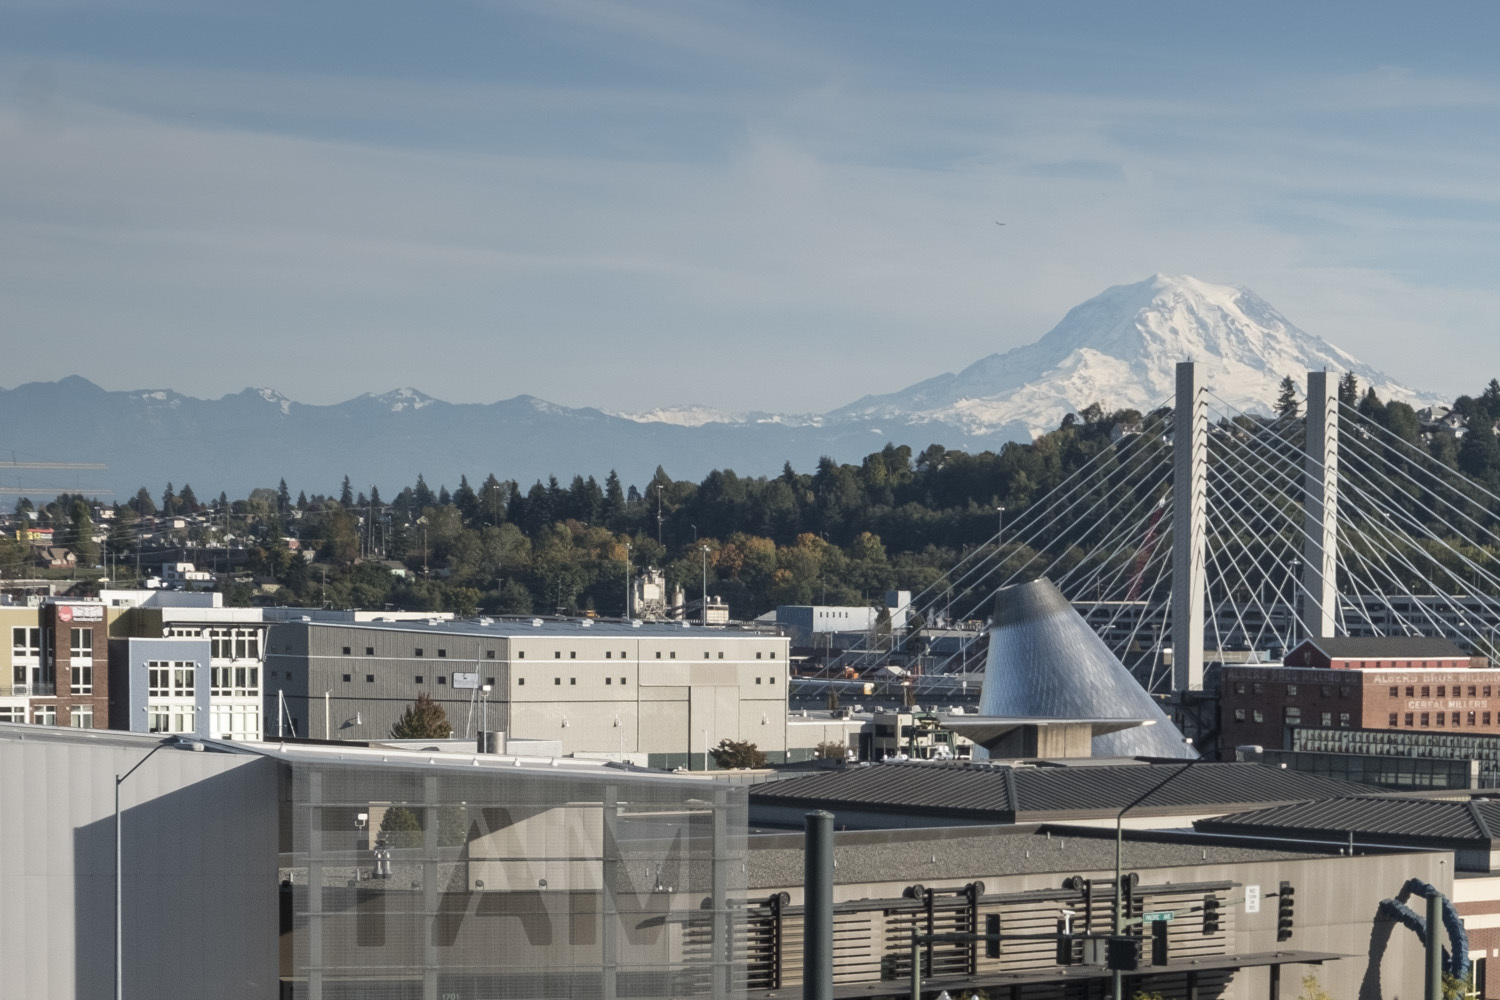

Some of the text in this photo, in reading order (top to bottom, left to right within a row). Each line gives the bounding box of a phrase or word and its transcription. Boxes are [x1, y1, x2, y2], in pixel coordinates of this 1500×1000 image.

[1408, 700, 1488, 709] CEREAL MILLERS
[312, 806, 714, 947] TAM
